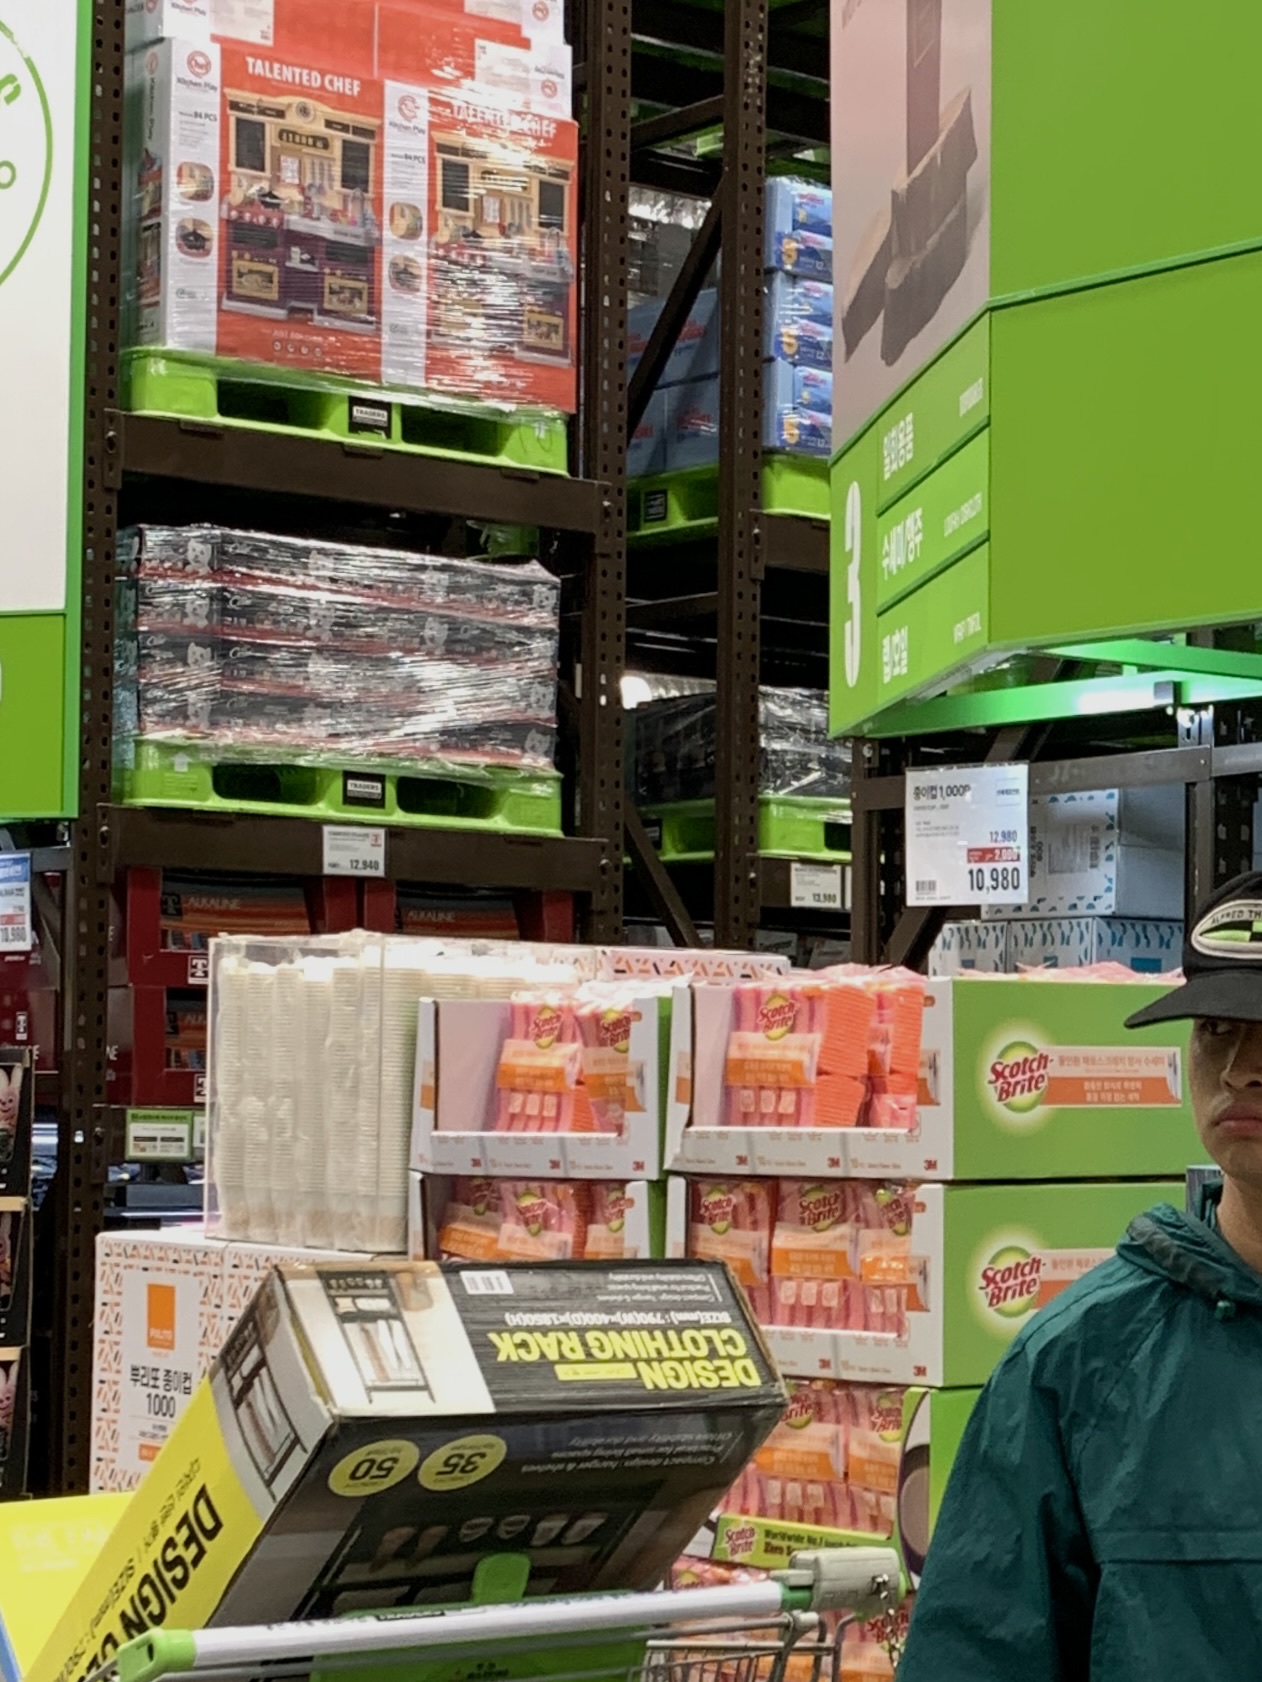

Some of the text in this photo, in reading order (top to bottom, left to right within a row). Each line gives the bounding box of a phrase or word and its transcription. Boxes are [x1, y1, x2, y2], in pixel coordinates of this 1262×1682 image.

[245, 56, 361, 96] TALENTED CHEF
[844, 480, 861, 688] 3
[968, 867, 1020, 894] 10,980
[1211, 910, 1245, 925] ALFRED
[758, 1000, 797, 1021] Scotch
[997, 1073, 1046, 1103] Brite
[471, 1158, 482, 1168] 3M
[549, 1159, 561, 1170] 3M
[633, 1161, 645, 1172] 3M
[736, 1155, 748, 1166] 3M
[827, 1157, 840, 1168] 3M
[924, 1159, 937, 1171] 3M
[799, 1192, 841, 1216] Scotch
[988, 1278, 1038, 1308] Brite
[494, 1328, 748, 1363] CLOTHING RACK
[162, 1369, 193, 1395] 종이컵
[636, 1358, 762, 1390] DESIGN
[913, 1365, 927, 1378] 3M
[146, 1392, 176, 1418] 1000
[350, 1457, 399, 1480] 50
[436, 1452, 487, 1475] 35
[118, 1484, 224, 1641] DESIGN
